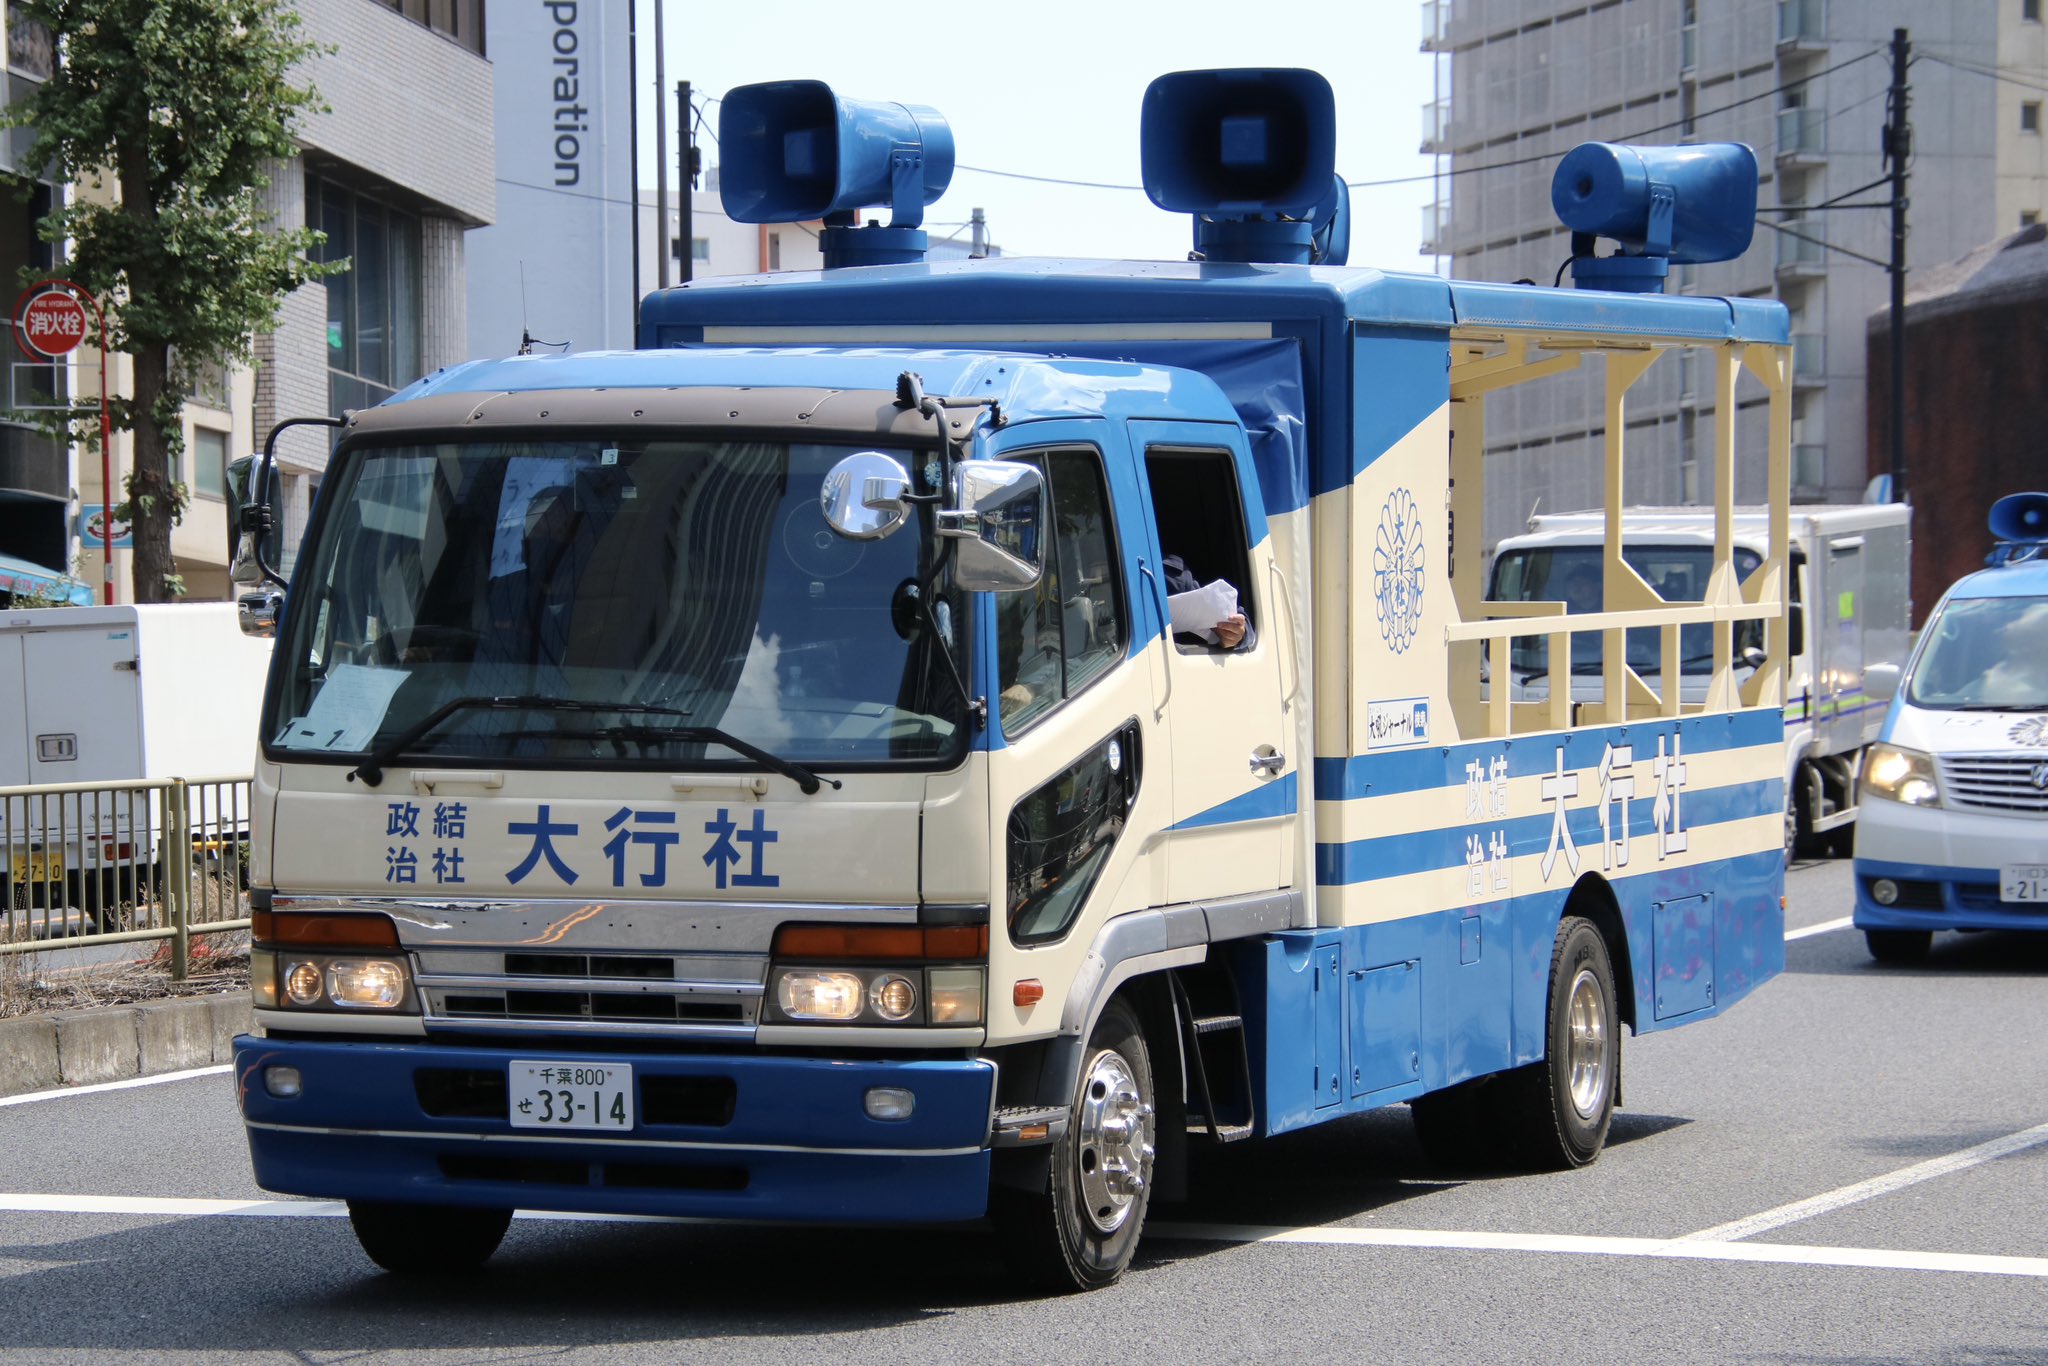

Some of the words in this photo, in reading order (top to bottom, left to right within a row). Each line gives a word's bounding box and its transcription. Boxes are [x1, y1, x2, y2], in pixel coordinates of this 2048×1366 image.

[543, 0, 588, 186] poration
[30, 311, 81, 336] 消火栓
[34, 300, 47, 308] FIRE
[505, 804, 780, 889] 大行社
[1541, 732, 1688, 883] 大行社
